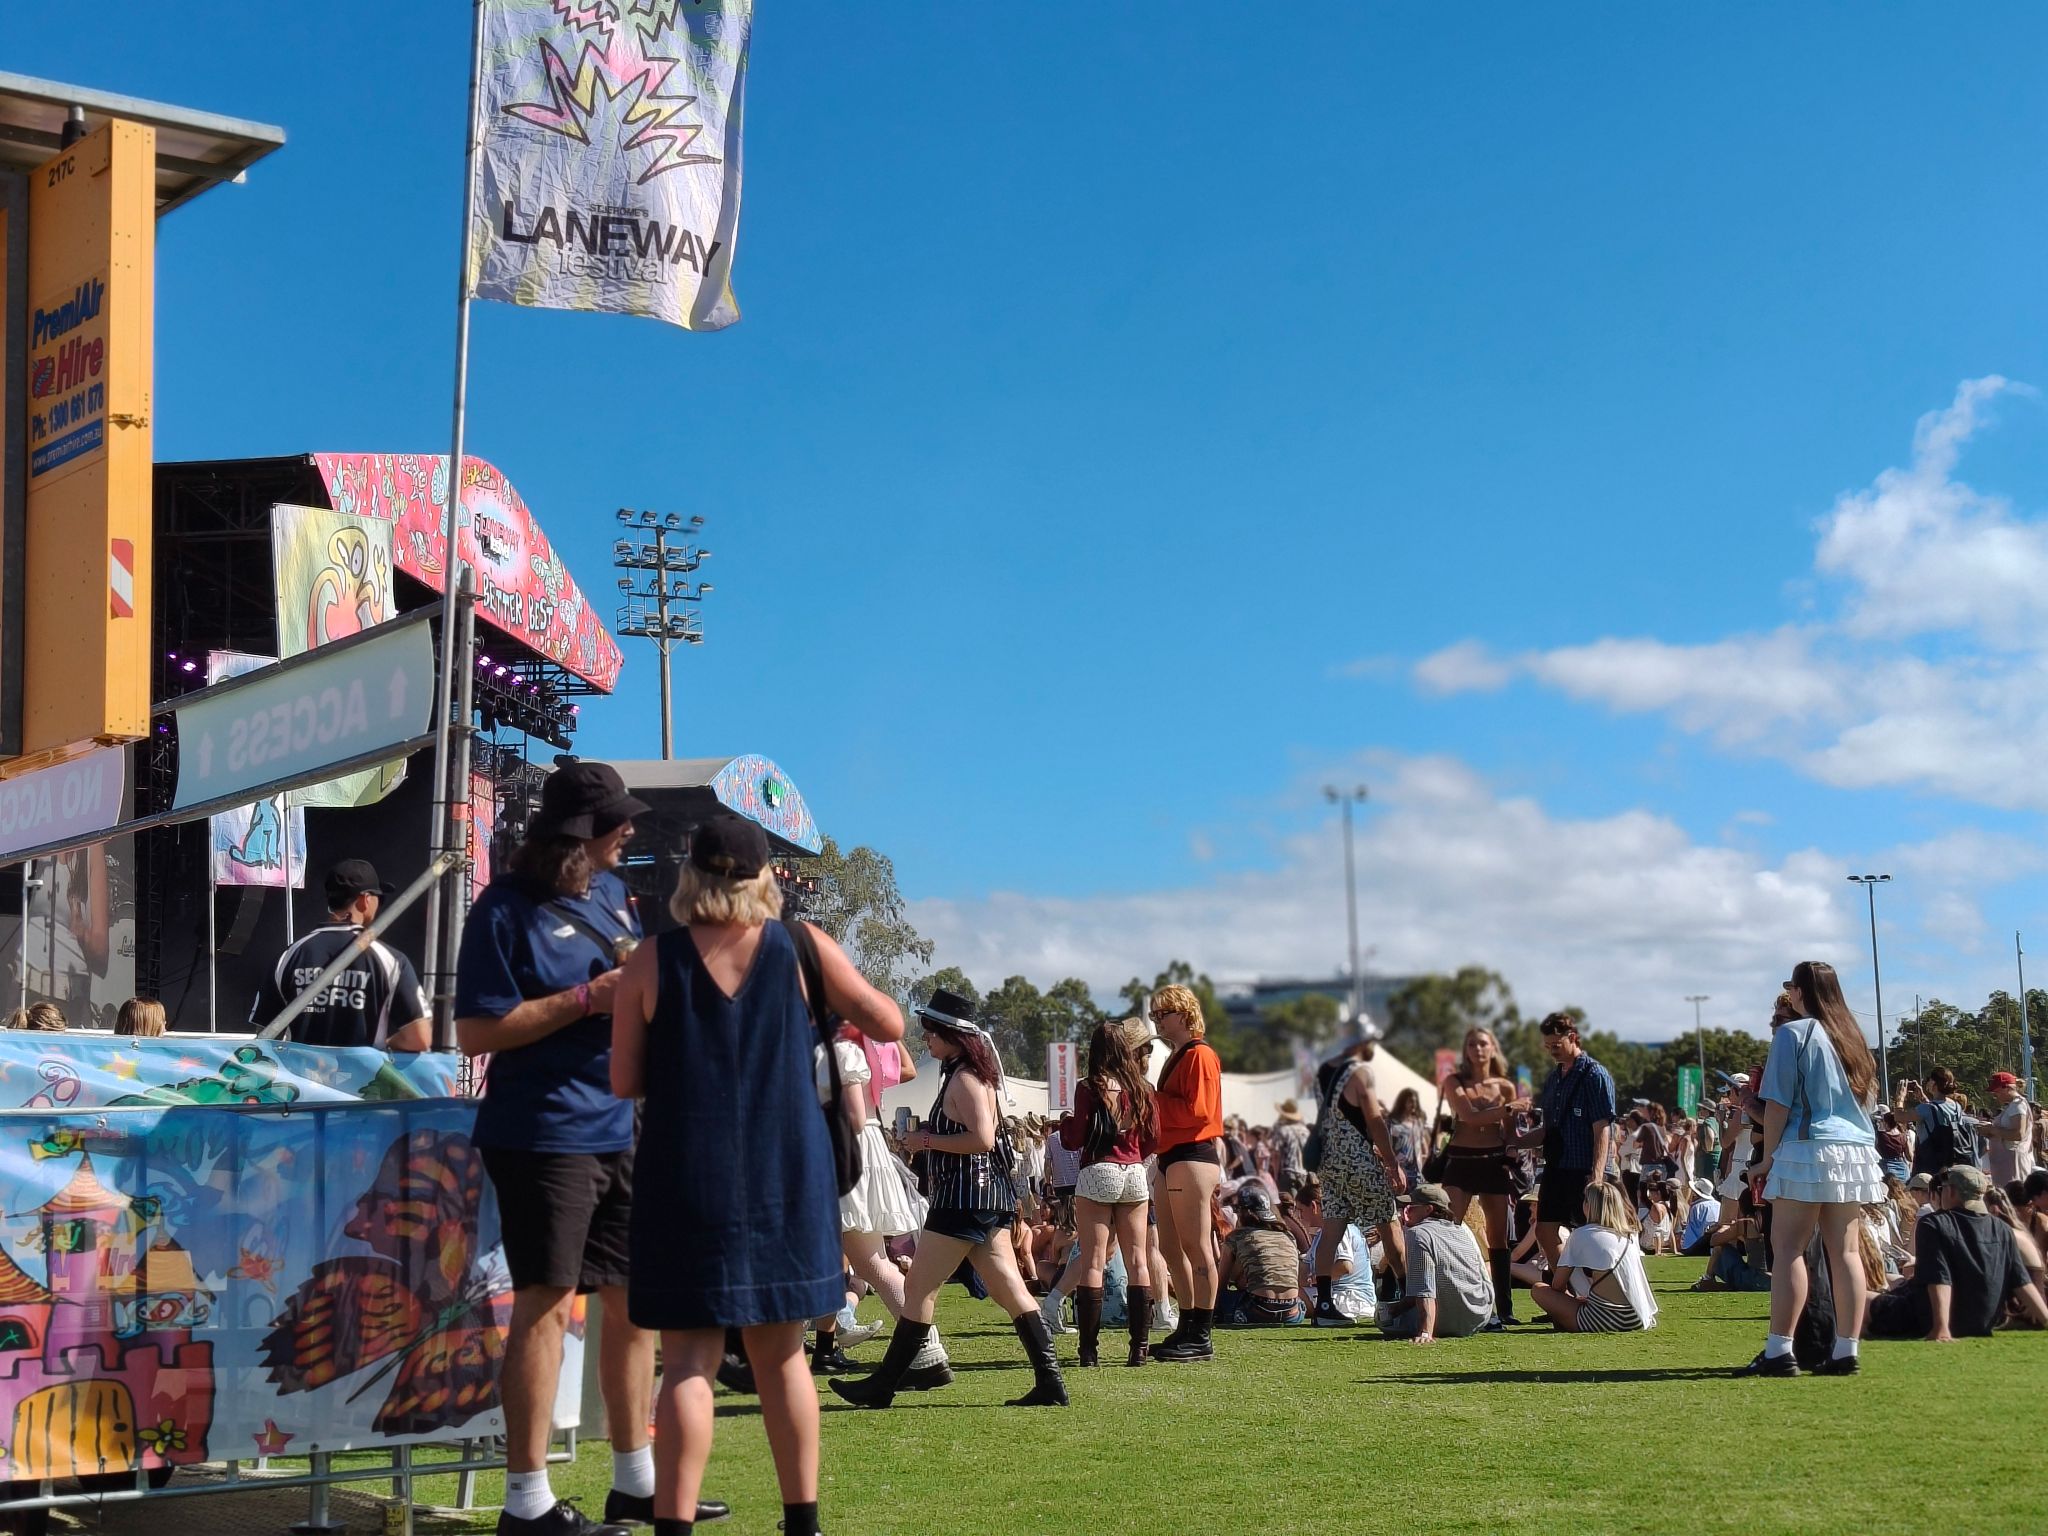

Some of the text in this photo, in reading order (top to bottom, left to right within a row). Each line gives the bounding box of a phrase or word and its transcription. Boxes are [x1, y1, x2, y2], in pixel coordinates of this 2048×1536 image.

[48, 155, 76, 188] 217C
[503, 201, 721, 277] LANEWAY
[558, 242, 670, 284] festival
[56, 334, 103, 394] Hire
[482, 571, 554, 631] BETTER BEST
